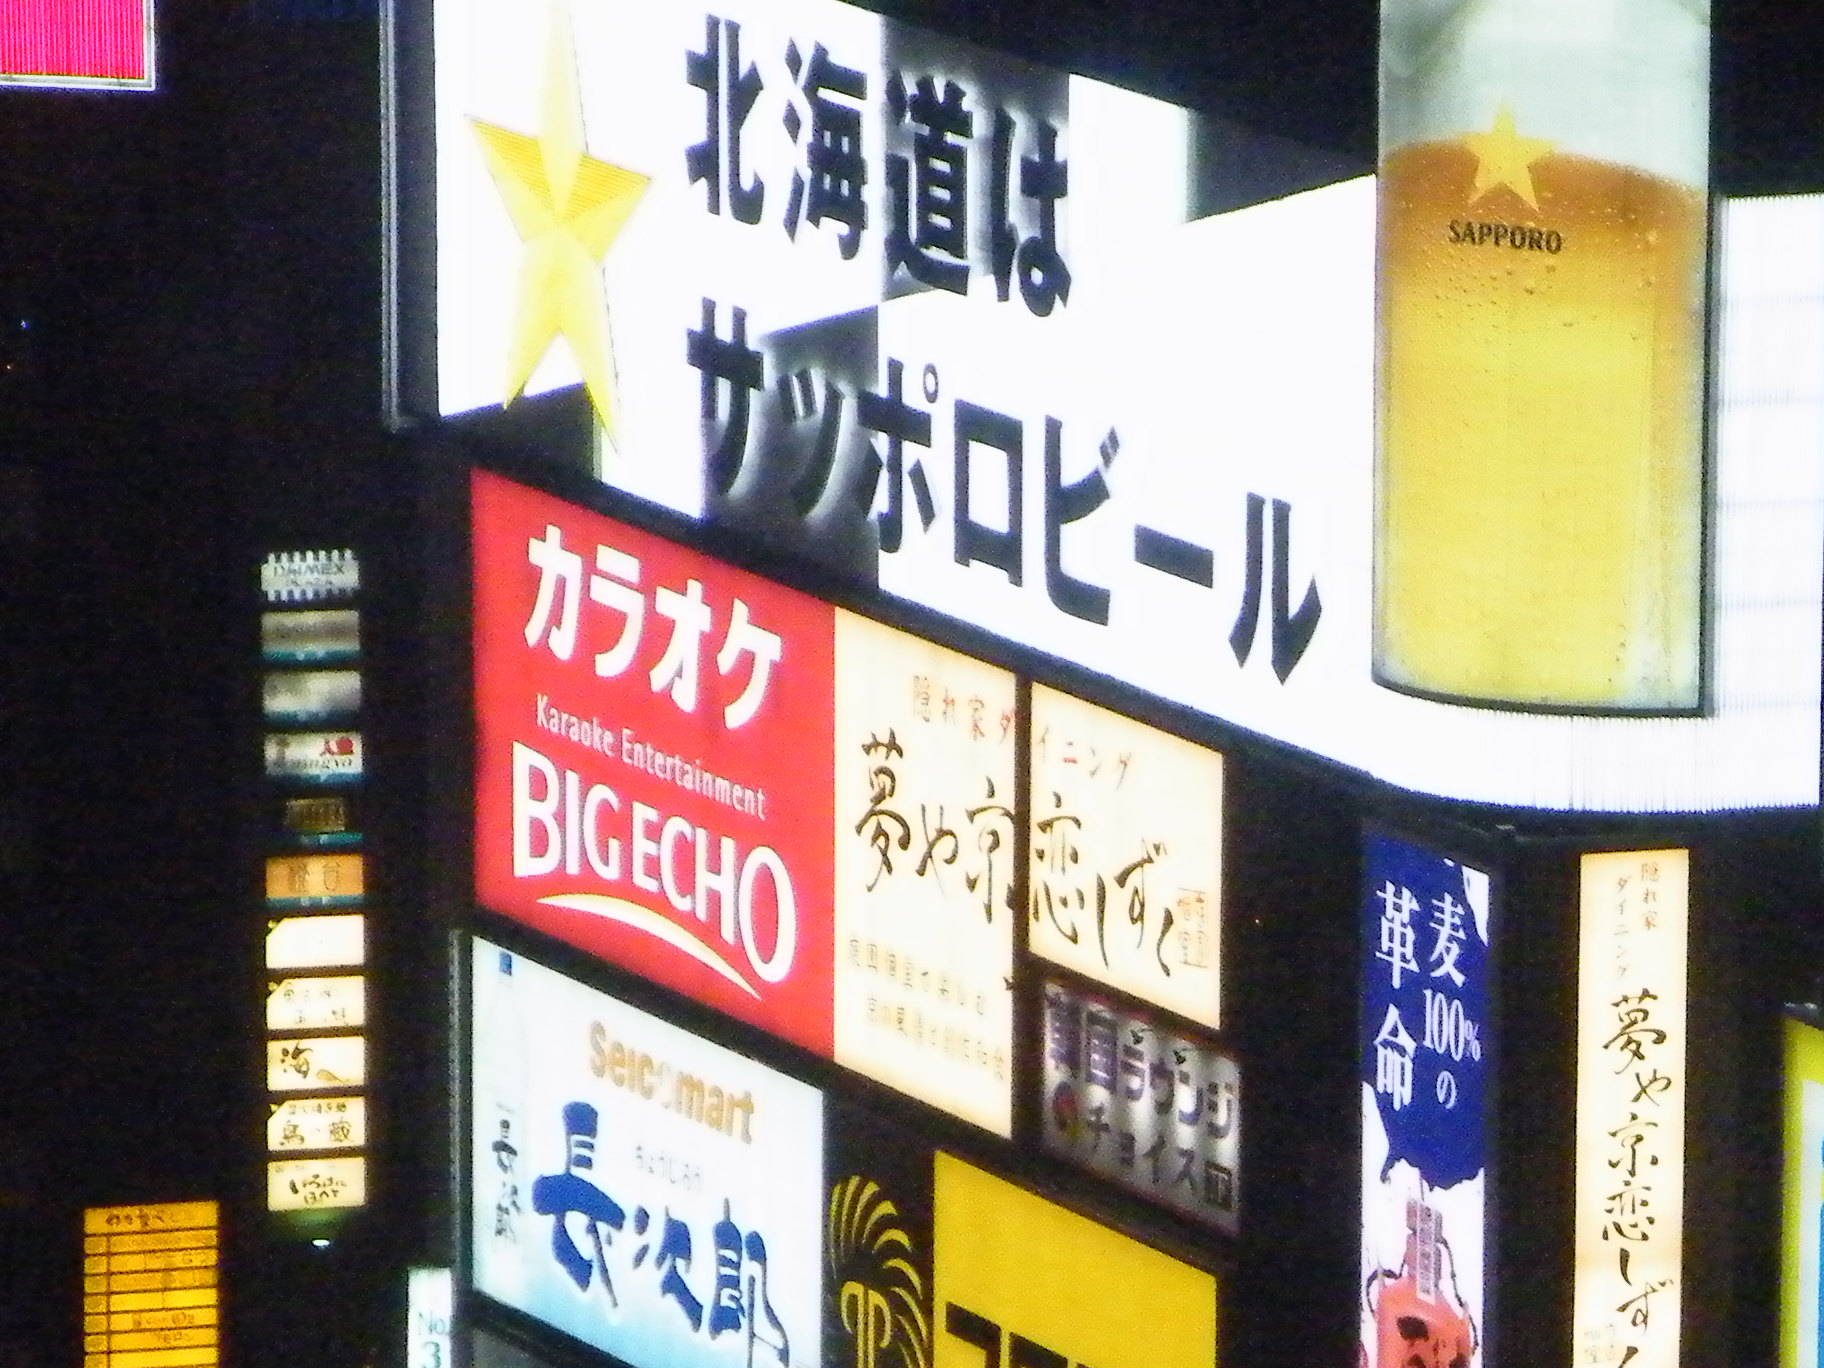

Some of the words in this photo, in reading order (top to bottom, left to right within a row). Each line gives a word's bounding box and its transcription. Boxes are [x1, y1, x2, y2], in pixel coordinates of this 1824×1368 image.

[684, 13, 1072, 318] 北海道は
[1447, 218, 1564, 255] SAPPORO
[686, 296, 1323, 686] サッポロビール
[523, 523, 784, 731] カラオケ
[511, 739, 621, 882] BIG
[631, 800, 799, 984] ECHO
[536, 692, 615, 760] Karaoke
[621, 725, 767, 823] Entertainment
[1373, 879, 1421, 1112] 革命
